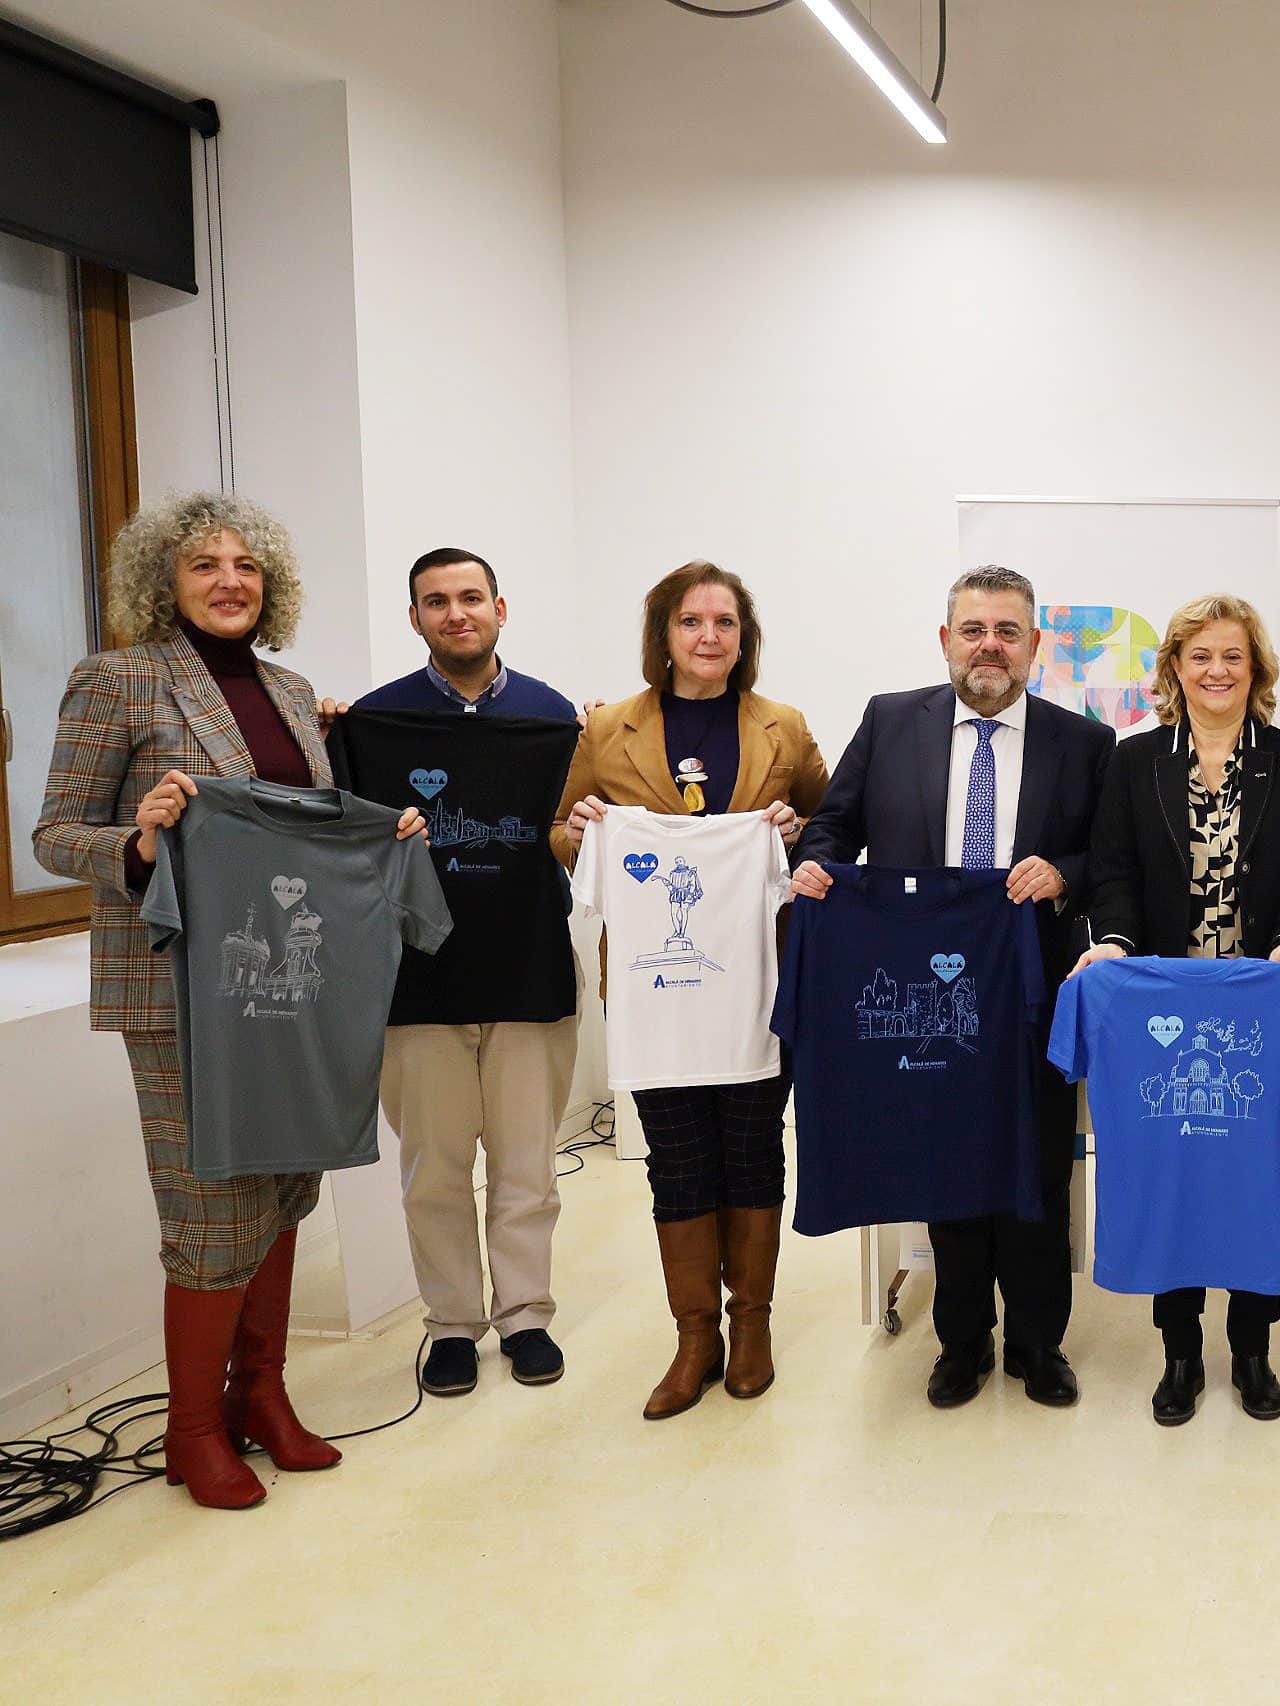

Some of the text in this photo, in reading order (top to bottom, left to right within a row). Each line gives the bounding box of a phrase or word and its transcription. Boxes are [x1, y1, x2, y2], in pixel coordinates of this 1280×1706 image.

[411, 776, 445, 785] ALCALÁ
[626, 859, 656, 870] ALCALÁ
[933, 960, 963, 969] ALCALÁ
[1150, 1023, 1181, 1032] ALCALÁ
